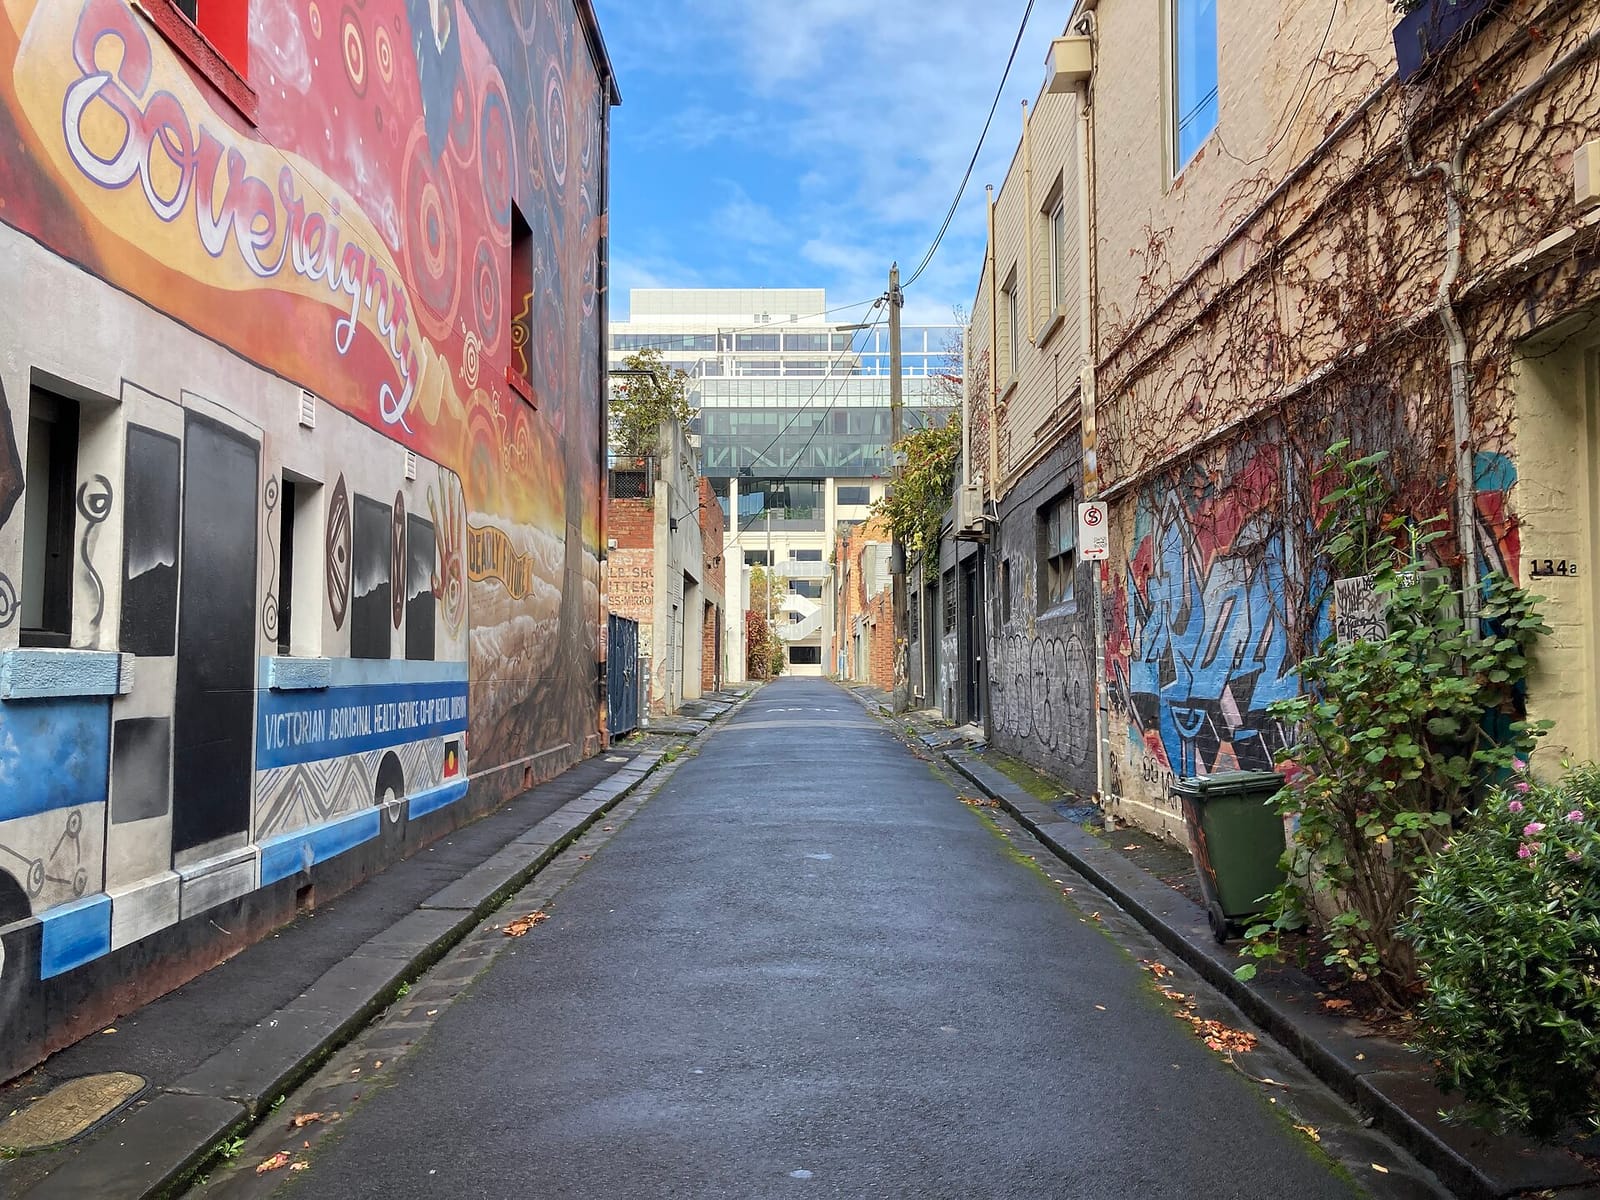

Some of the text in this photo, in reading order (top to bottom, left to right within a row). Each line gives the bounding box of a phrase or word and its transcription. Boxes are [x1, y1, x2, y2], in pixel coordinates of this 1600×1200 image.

[469, 529, 501, 574] DEADLY
[1530, 558, 1577, 576] 134a
[265, 708, 326, 750] VICTORIAN
[329, 704, 371, 741] ABORIGINAL
[374, 702, 397, 733] HEALTH
[397, 700, 419, 729] SERVICE
